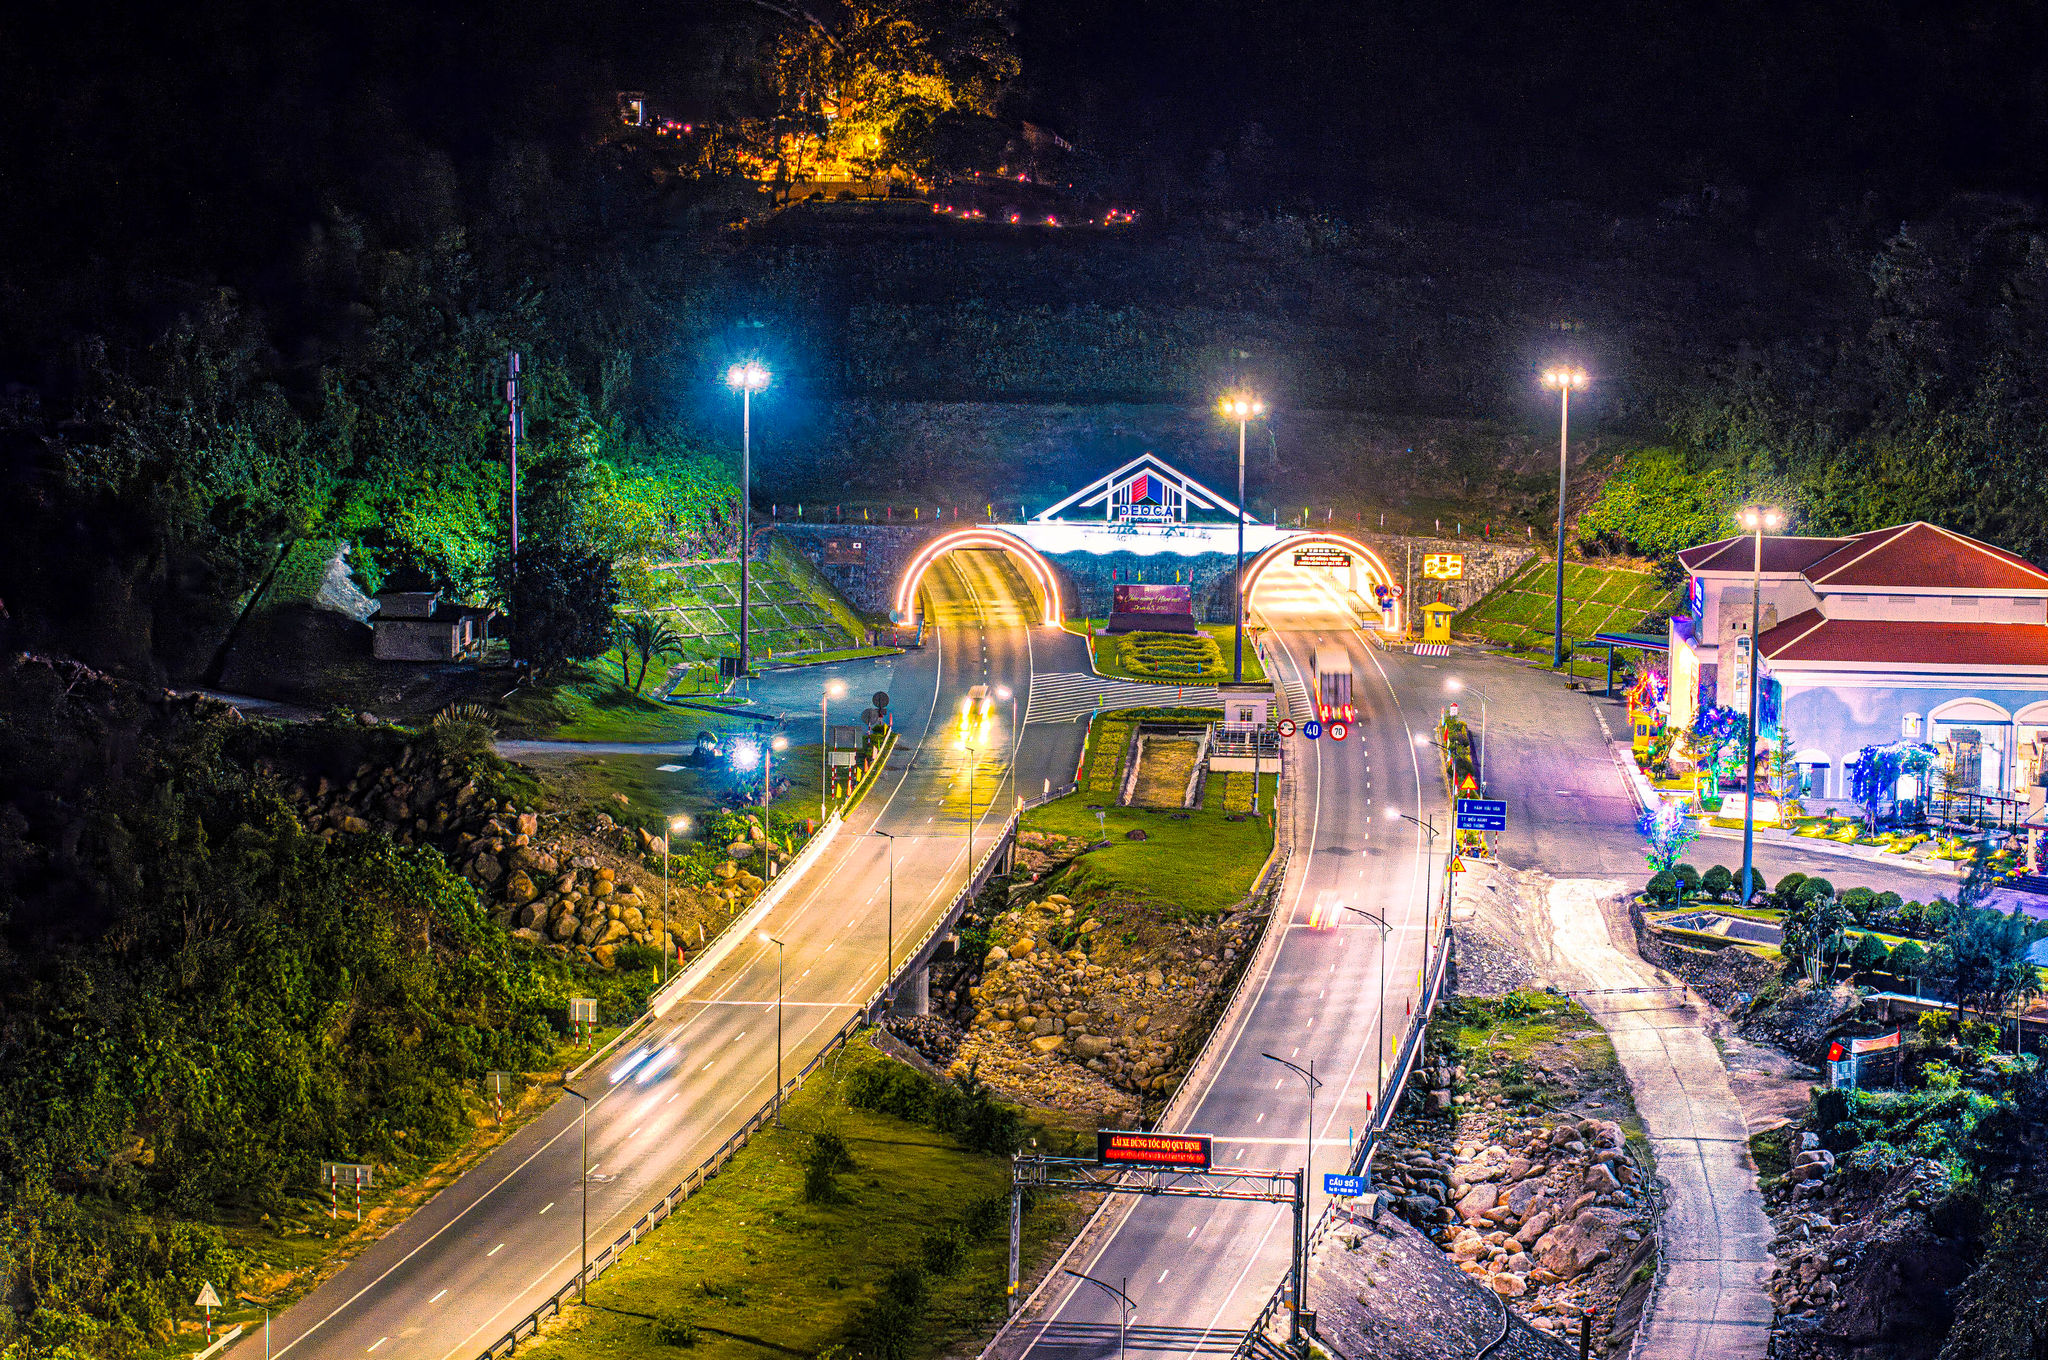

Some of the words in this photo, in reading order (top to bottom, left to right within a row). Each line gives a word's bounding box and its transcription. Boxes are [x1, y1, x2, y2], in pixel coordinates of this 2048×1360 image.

[1120, 505, 1173, 516] DEOCA
[1306, 724, 1318, 736] 40
[1122, 1138, 1130, 1147] XE
[1148, 1137, 1161, 1149] TỐC
[1161, 1140, 1171, 1151] ĐỘ
[1171, 1141, 1185, 1152] QUY
[1184, 1142, 1200, 1153] ĐỊNH
[1344, 1179, 1355, 1187] SỐ
